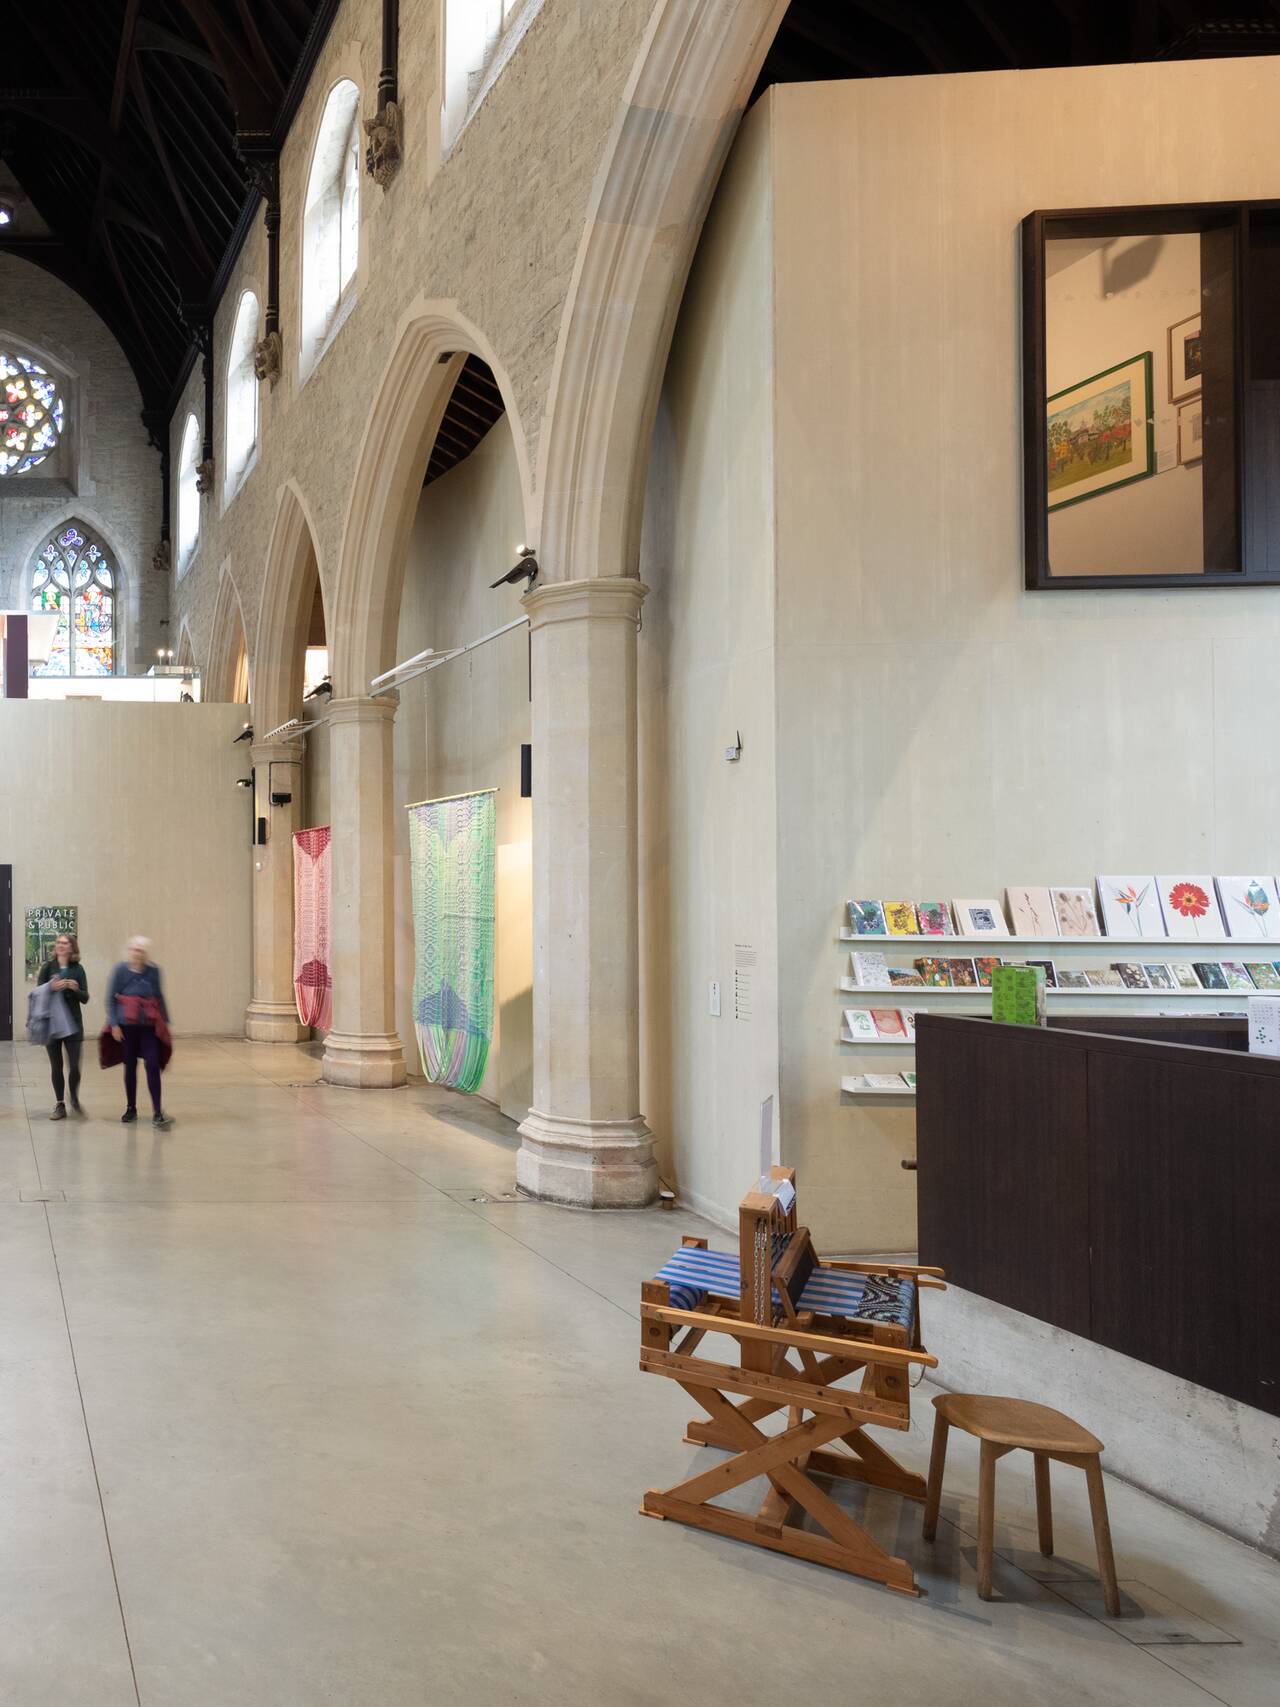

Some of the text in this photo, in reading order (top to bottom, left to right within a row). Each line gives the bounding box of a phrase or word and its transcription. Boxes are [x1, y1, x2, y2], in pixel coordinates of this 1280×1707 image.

[28, 909, 75, 918] PRIVATE
[28, 920, 74, 929] & PUBLIC
